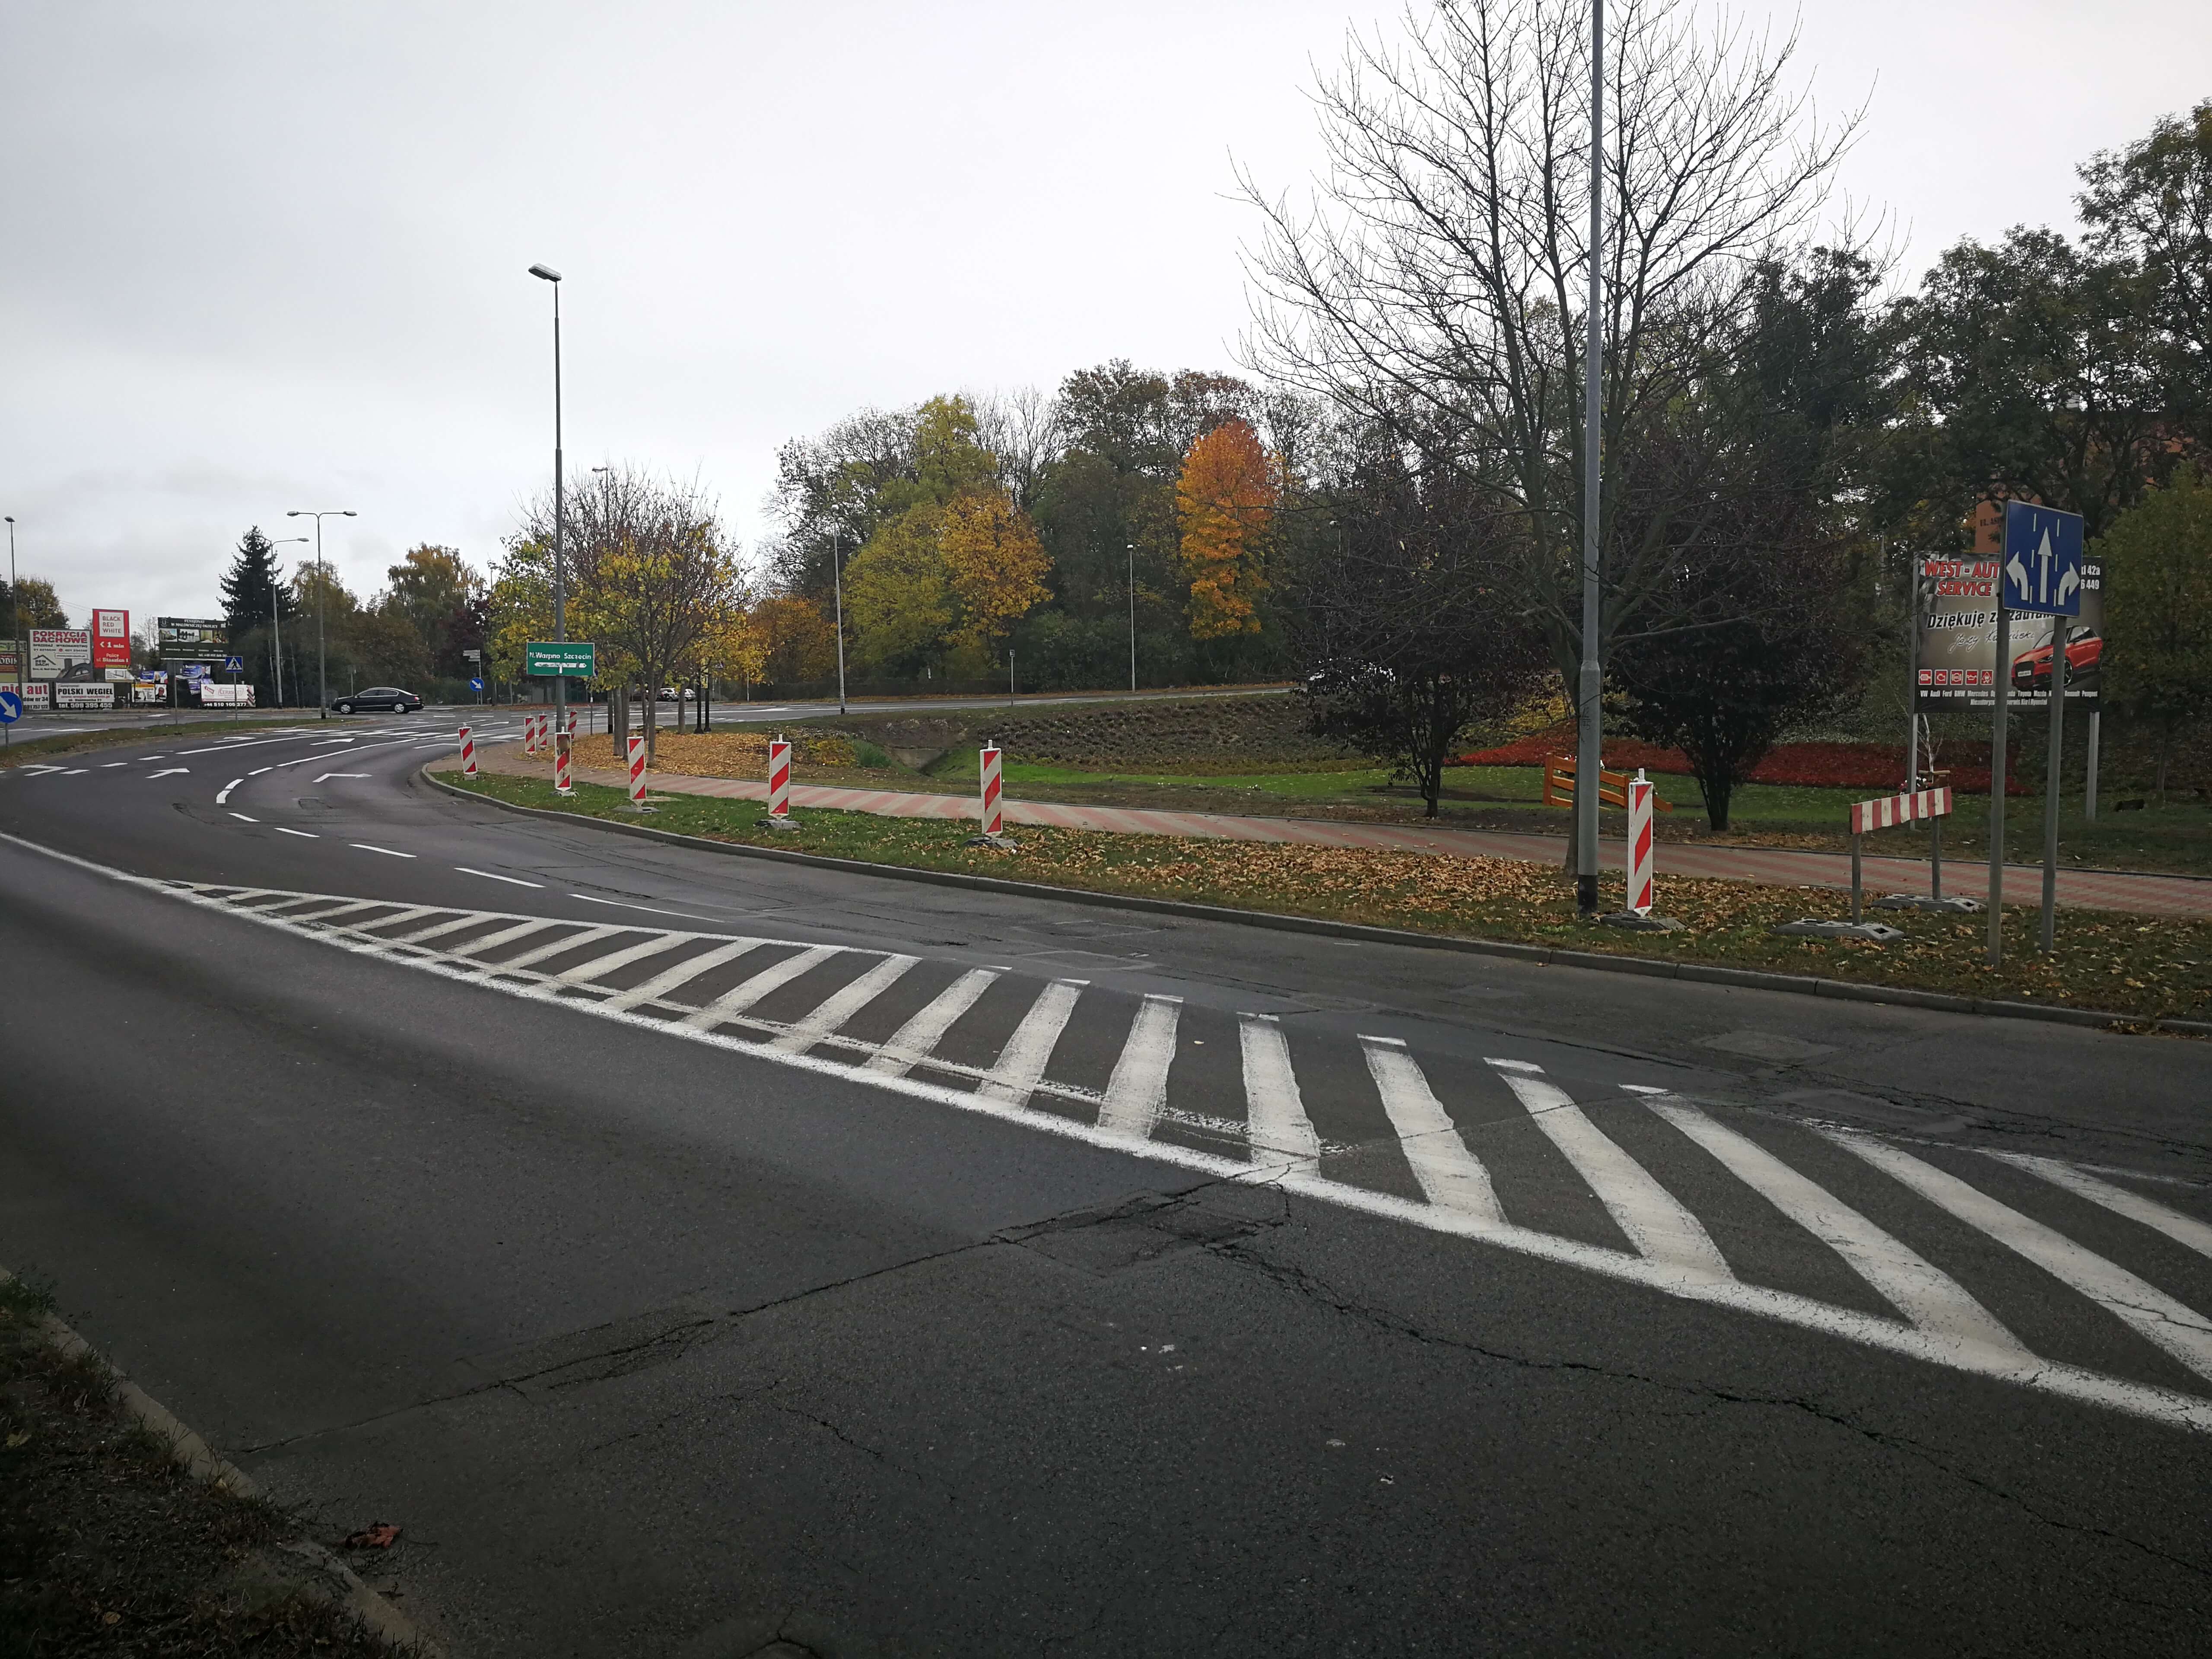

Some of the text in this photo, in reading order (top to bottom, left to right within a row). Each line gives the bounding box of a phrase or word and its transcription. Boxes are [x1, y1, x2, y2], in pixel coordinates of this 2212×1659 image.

[1925, 560, 1963, 577] WEST
[1971, 561, 2000, 578] AUT
[2087, 565, 2101, 575] 42a
[1936, 581, 1993, 597] SERVICE
[2086, 579, 2100, 590] 449
[1927, 610, 1985, 629] Dziękuję
[27, 684, 48, 695] aut
